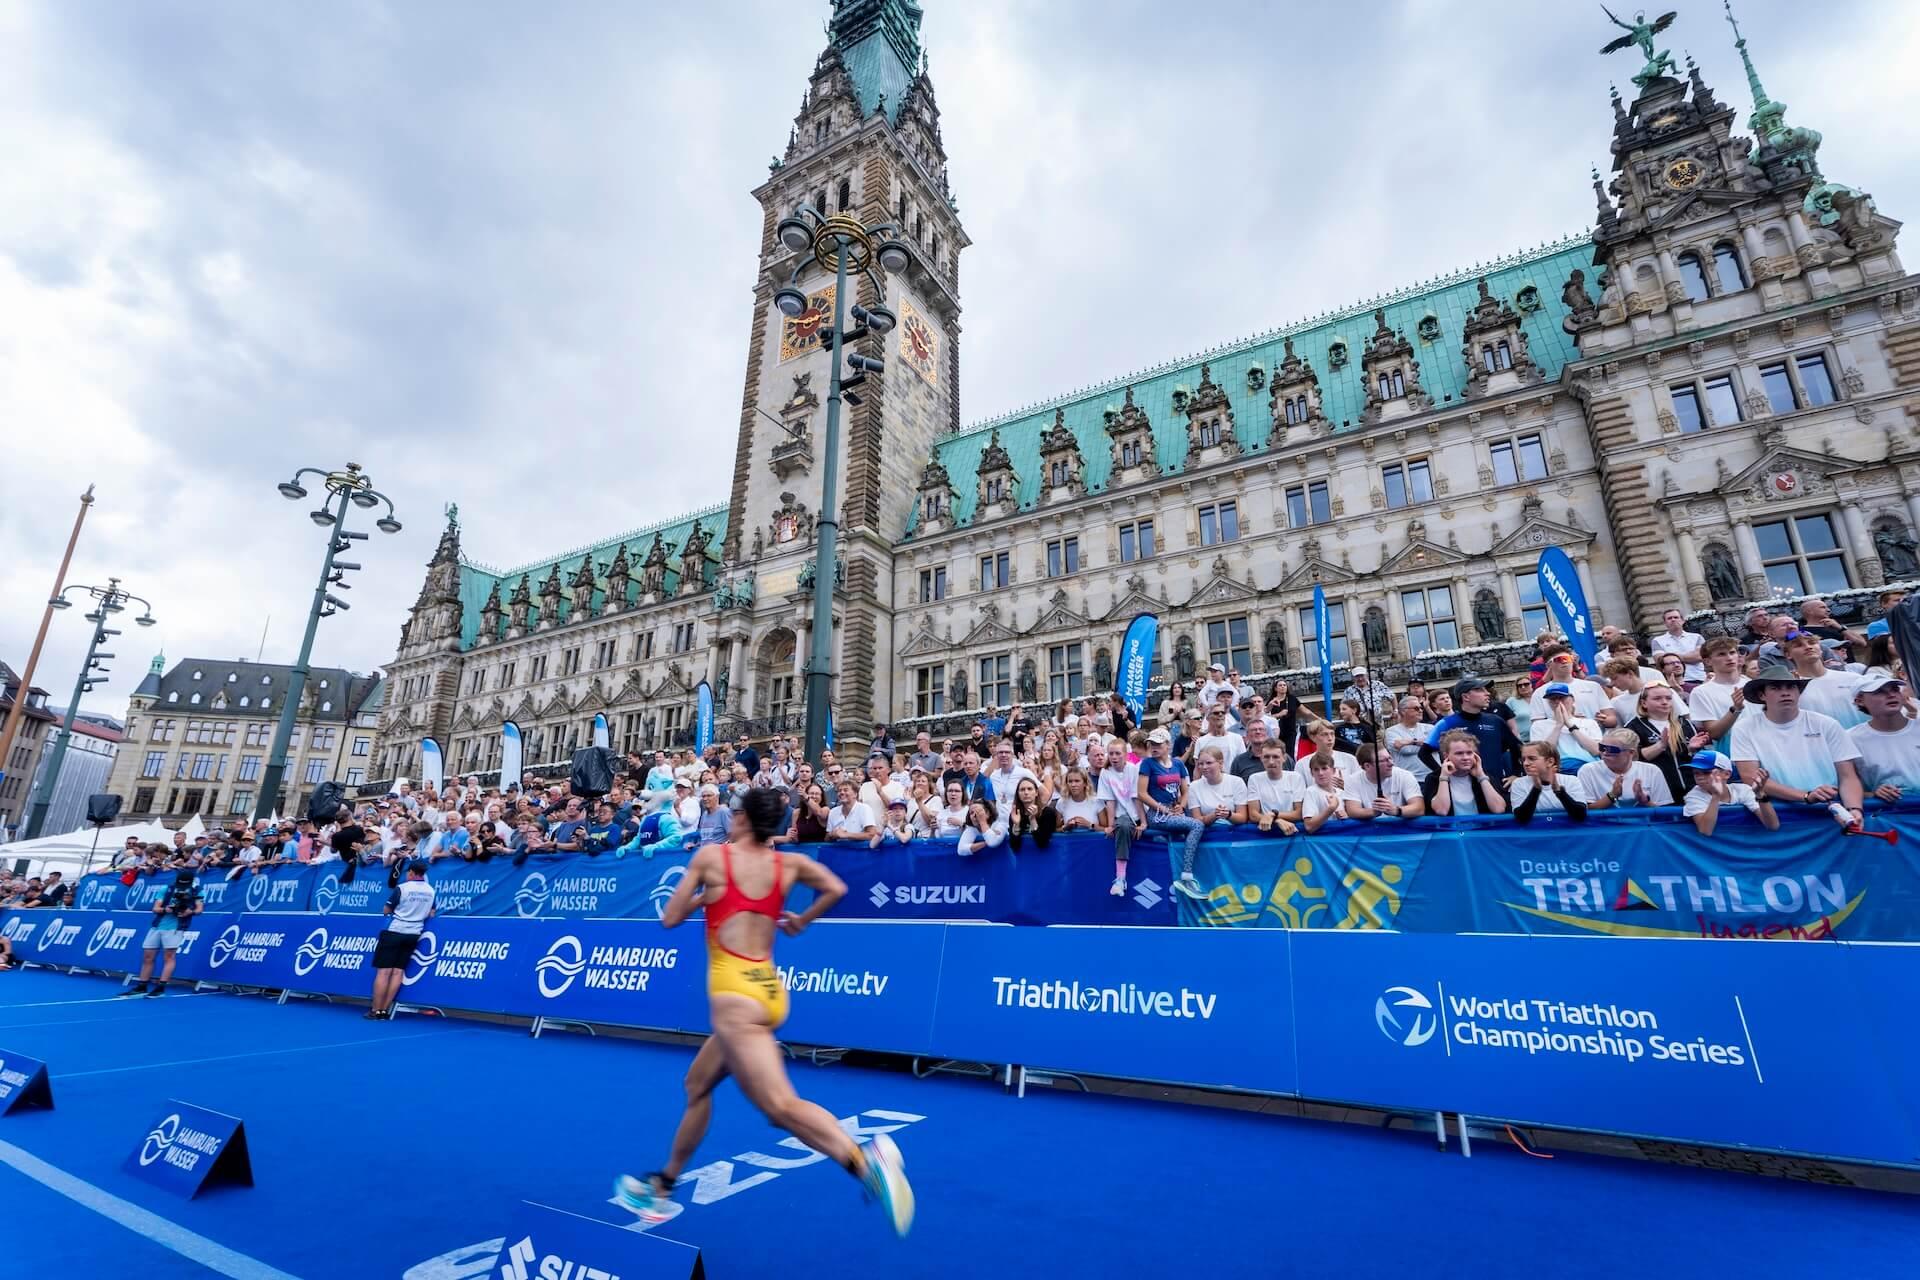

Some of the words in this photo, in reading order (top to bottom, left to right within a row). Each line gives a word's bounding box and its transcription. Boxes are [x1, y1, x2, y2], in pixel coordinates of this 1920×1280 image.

[1125, 639, 1140, 697] HAMBURG
[1133, 655, 1145, 696] WASSER
[1519, 858, 1621, 875] Deutsche
[94, 885, 117, 903] NTT
[268, 880, 299, 903] NTT
[434, 880, 490, 894] HAMBURG
[552, 877, 617, 893] HAMBURG
[894, 885, 986, 904] SUZUKI
[339, 894, 369, 907] WASSER
[551, 895, 598, 911] WASSER
[53, 925, 83, 946] NTT
[104, 928, 137, 950] NTT
[240, 933, 286, 947] HAMBURG
[232, 947, 268, 963] WASSER
[441, 940, 511, 960] HAMBURG
[589, 946, 678, 969] HAMBURG
[323, 952, 364, 970] WASSER
[434, 960, 487, 980] WASSER
[584, 968, 650, 991] WASSER
[777, 965, 889, 997] hlonlive.tv
[992, 976, 1217, 1019] Triathlonlive.tv
[1449, 995, 1529, 1022] World
[1530, 999, 1658, 1029] Triathlon
[1453, 1021, 1645, 1063] Championship
[1652, 1035, 1745, 1066] Series
[175, 1127, 222, 1156] HAMBURG
[164, 1145, 200, 1172] WASSER
